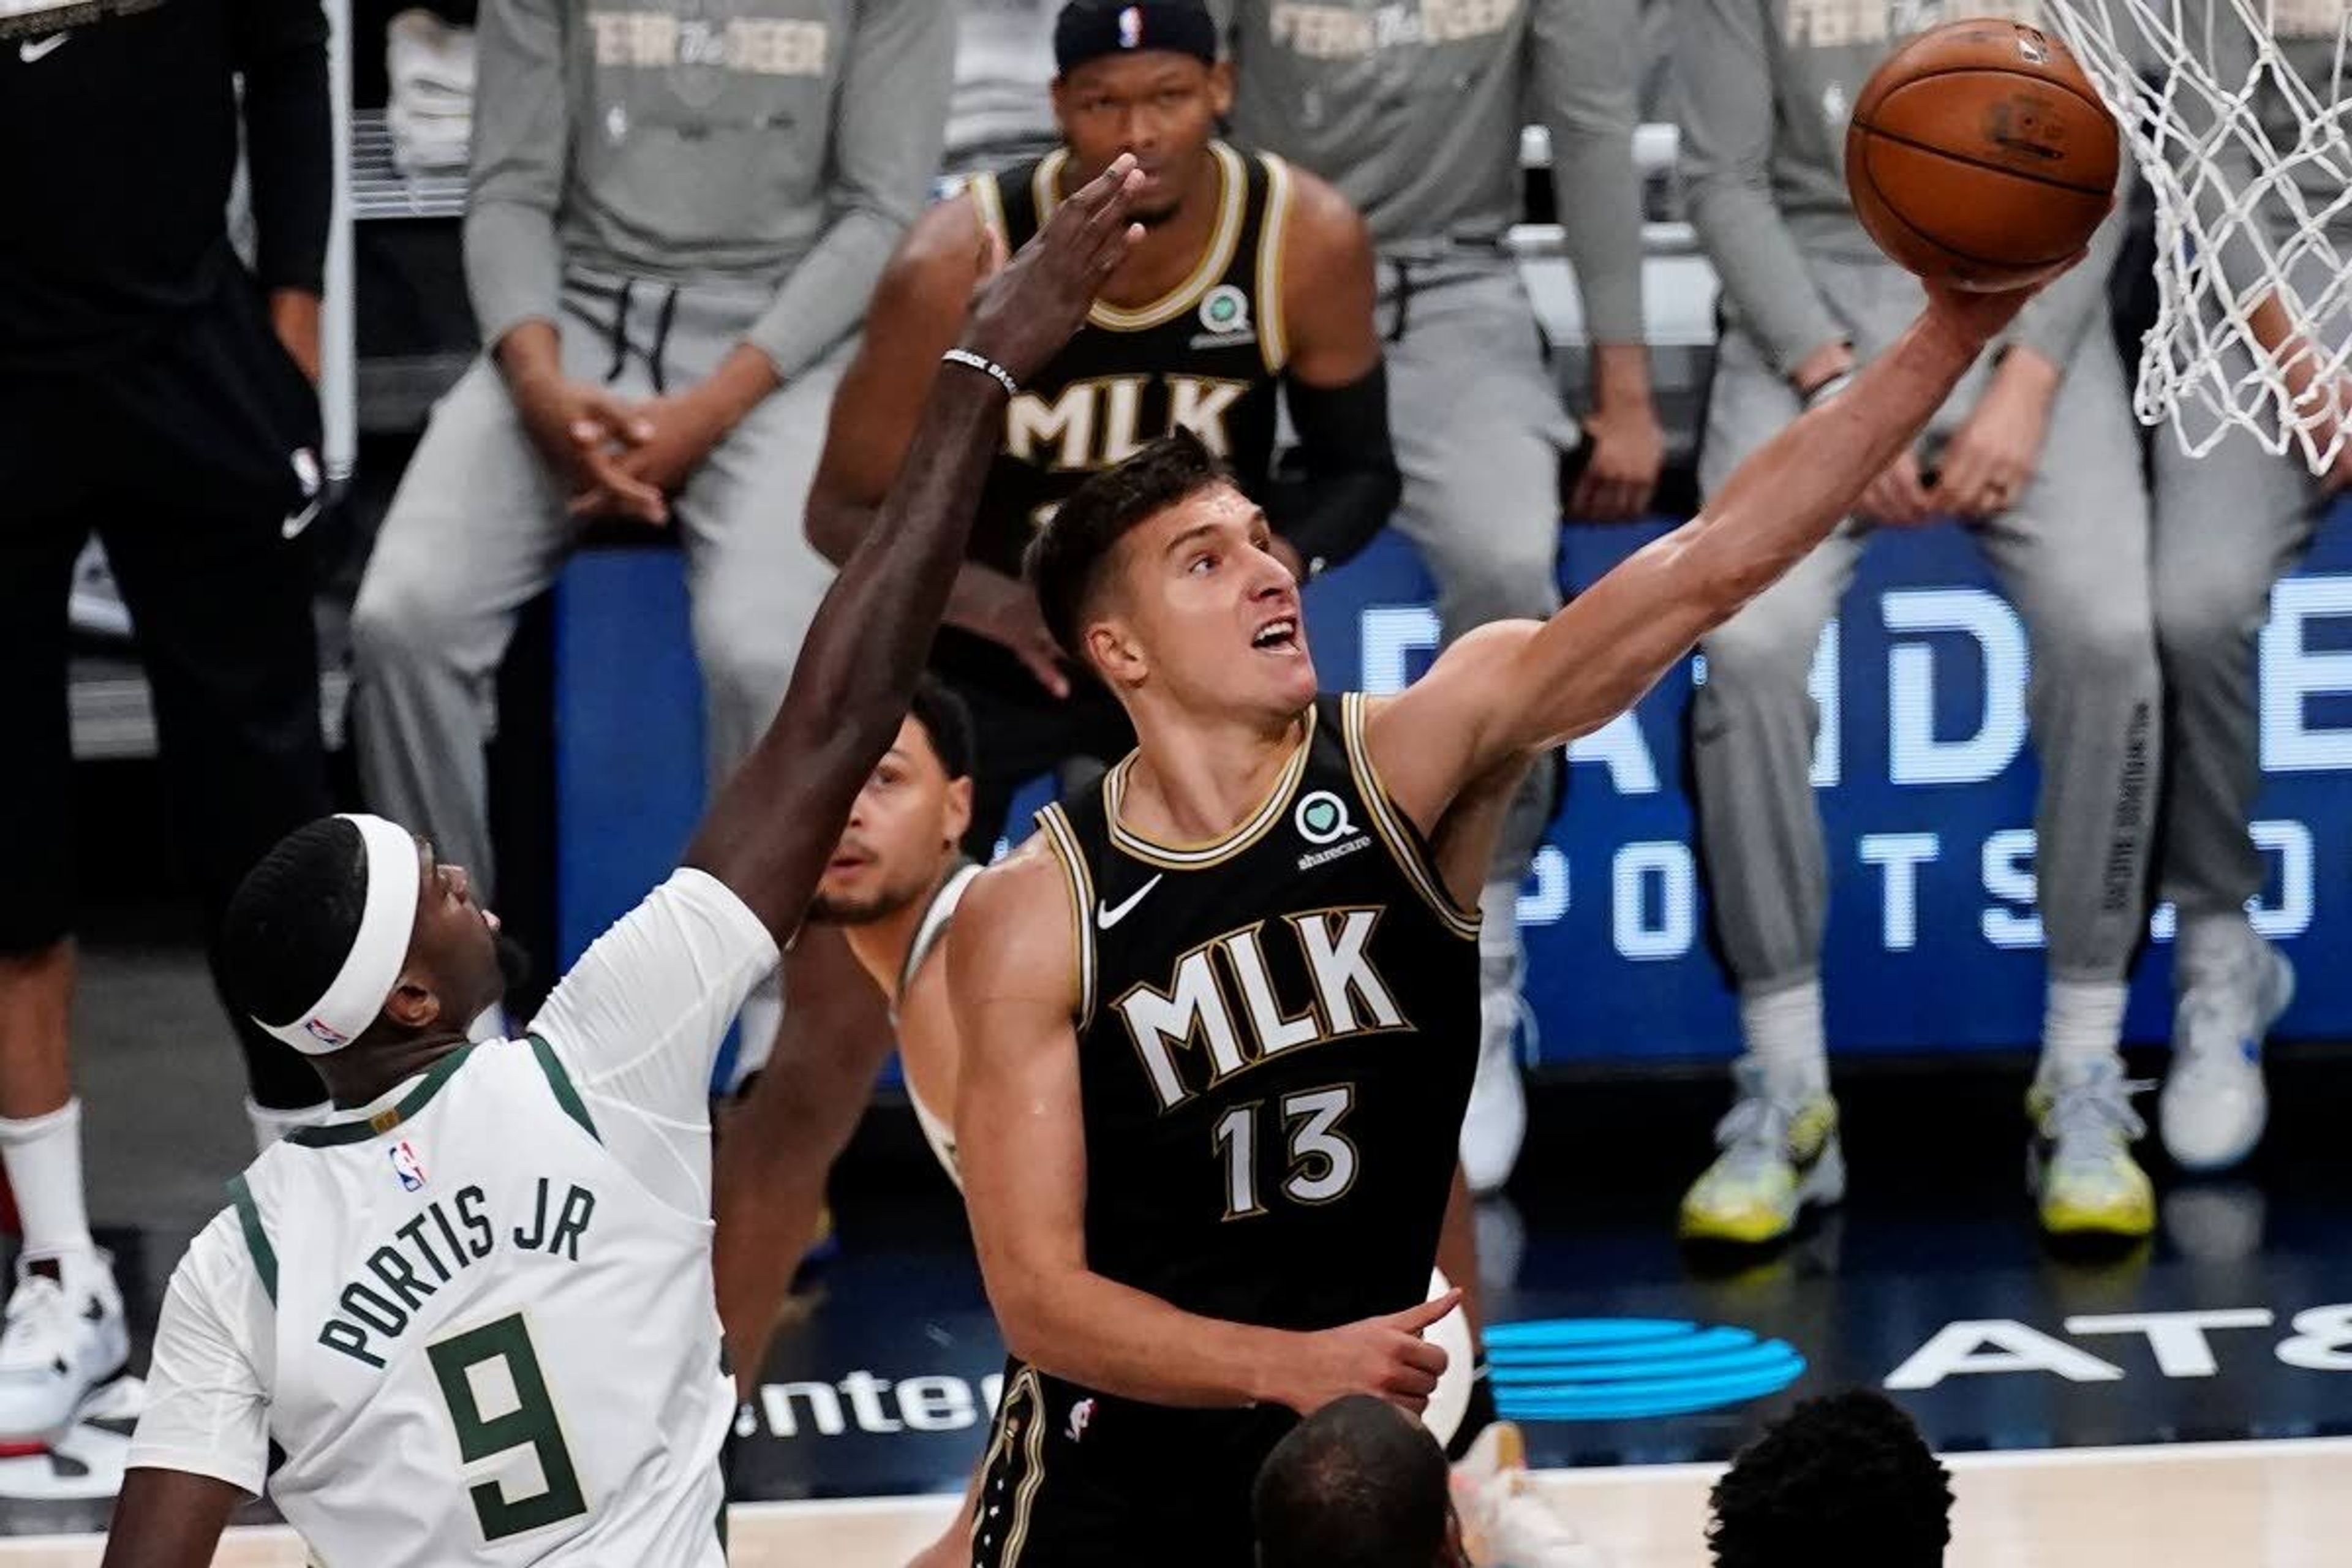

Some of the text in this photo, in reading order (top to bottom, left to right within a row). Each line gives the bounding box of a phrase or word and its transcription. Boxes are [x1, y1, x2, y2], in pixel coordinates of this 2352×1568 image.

[1003, 372, 1253, 473] MLK
[1297, 835, 1373, 870] sharecare
[1108, 905, 1419, 1118] MLK
[1210, 1081, 1360, 1222] 13
[318, 1177, 595, 1370] PORTIS JR
[424, 1311, 588, 1542] 9
